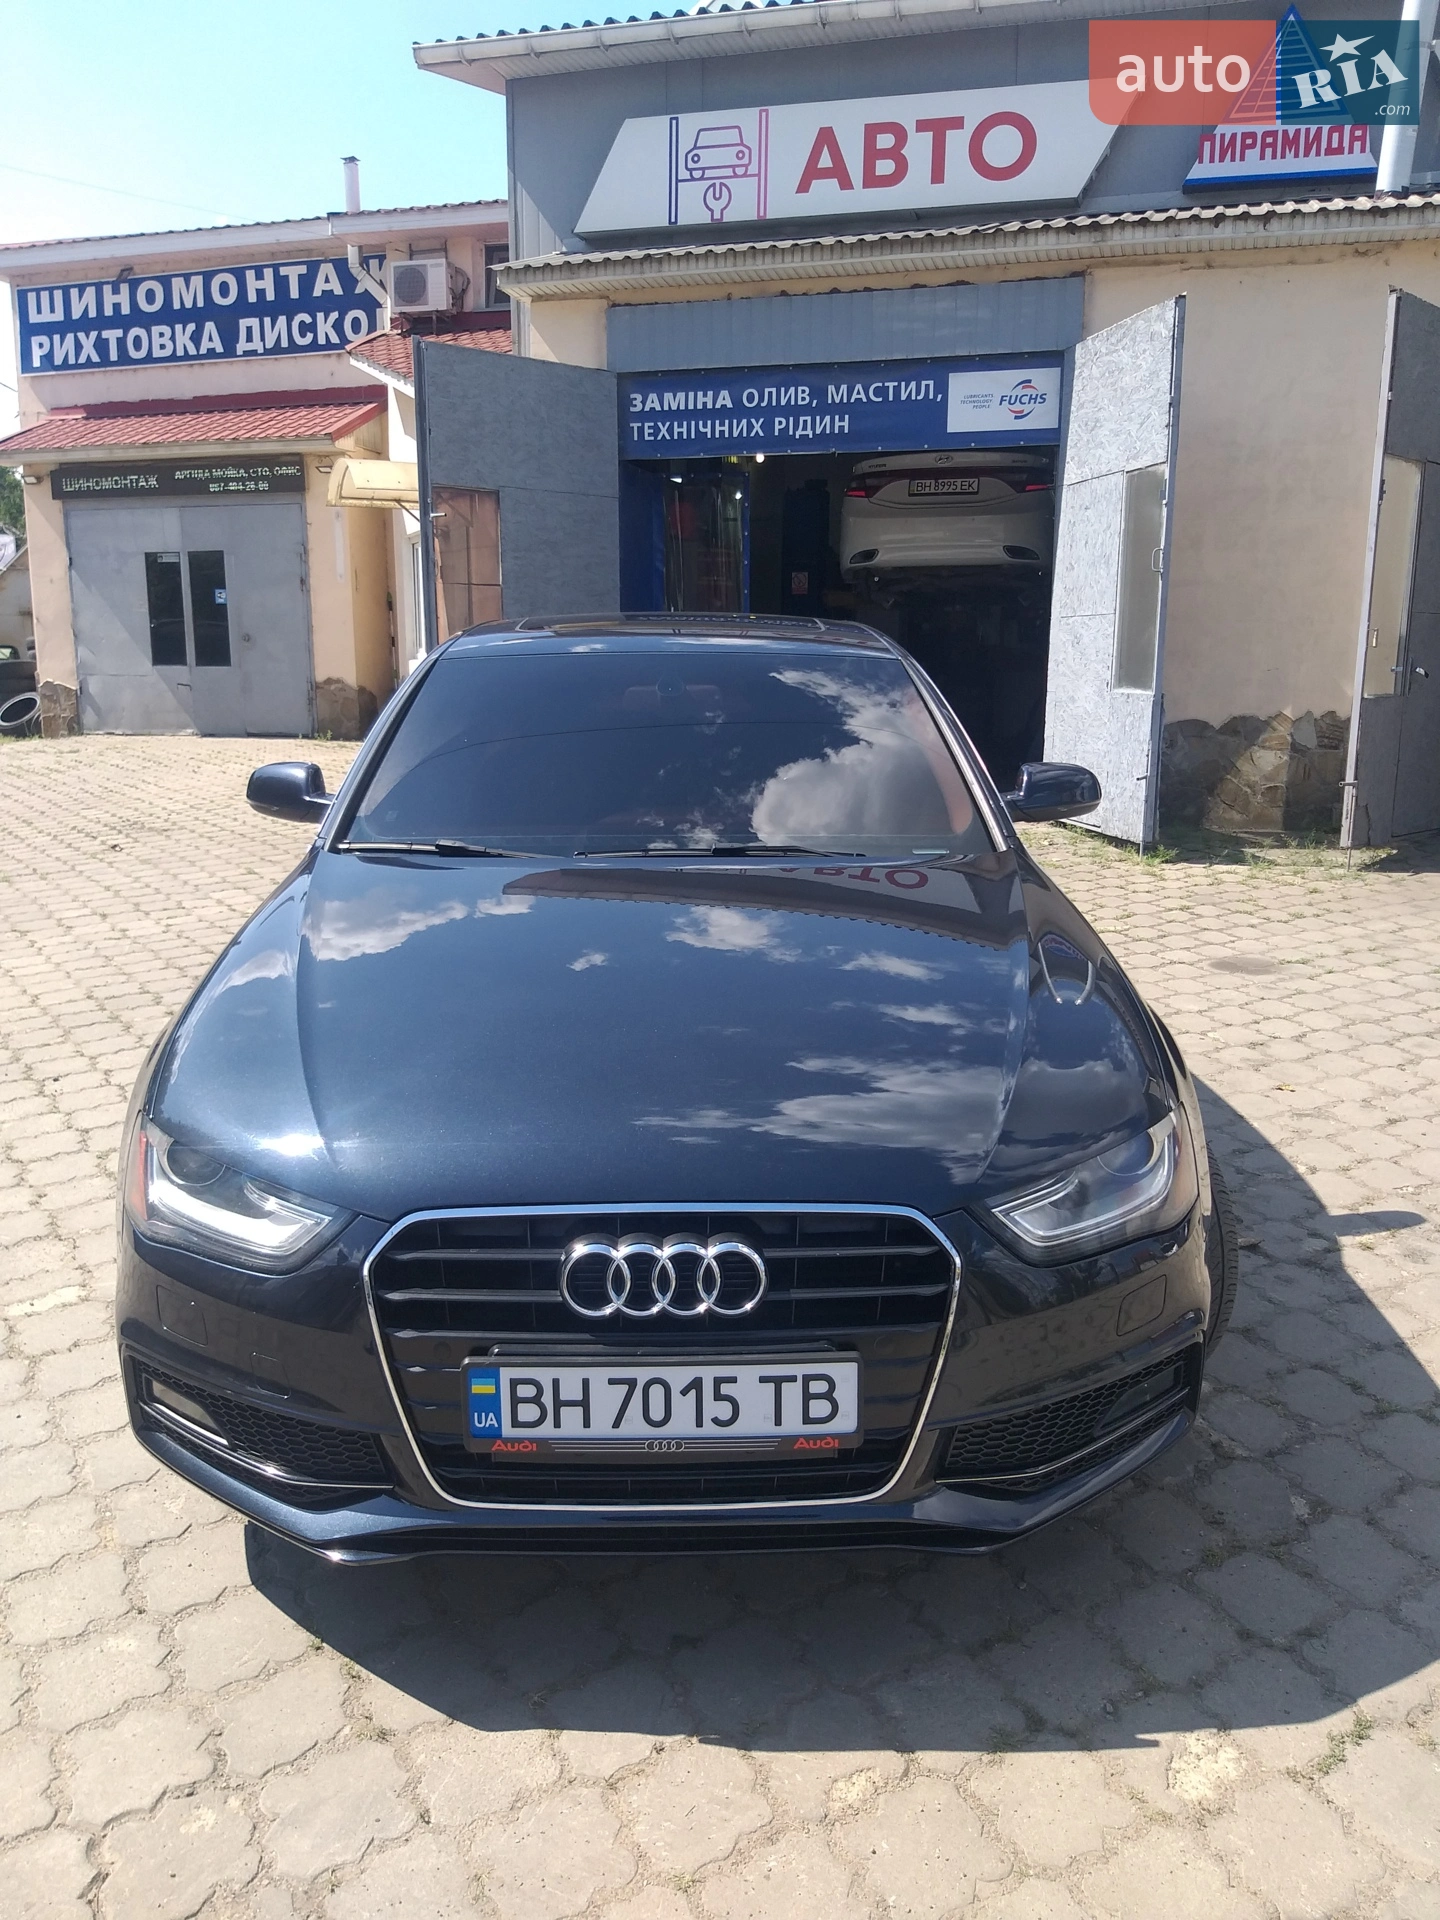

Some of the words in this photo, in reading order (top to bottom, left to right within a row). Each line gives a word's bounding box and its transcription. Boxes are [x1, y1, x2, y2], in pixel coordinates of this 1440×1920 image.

[795, 109, 1038, 196] АВТО
[1197, 123, 1369, 165] ПИРАМИДА
[31, 320, 224, 368] РИХТОВКА
[236, 308, 384, 356] ДИСКО
[629, 390, 733, 412] ЗАМІНА
[742, 386, 818, 408] ОЛИВ,
[827, 380, 943, 404] МАСТИЛ,
[998, 393, 1048, 407] FUCHS
[629, 418, 765, 441] ТЕХНІЧНИХ
[774, 414, 849, 439] РІДИН
[62, 474, 159, 492] ШИНОМОНТАЖ
[915, 481, 931, 492] BH
[934, 480, 958, 492] 8995
[960, 479, 976, 491] EK
[508, 1376, 591, 1429] BH
[607, 1375, 740, 1429] 7015
[758, 1373, 839, 1427] TB
[474, 1412, 498, 1428] UA
[491, 1439, 537, 1452] Audi
[793, 1436, 839, 1449] Audi
